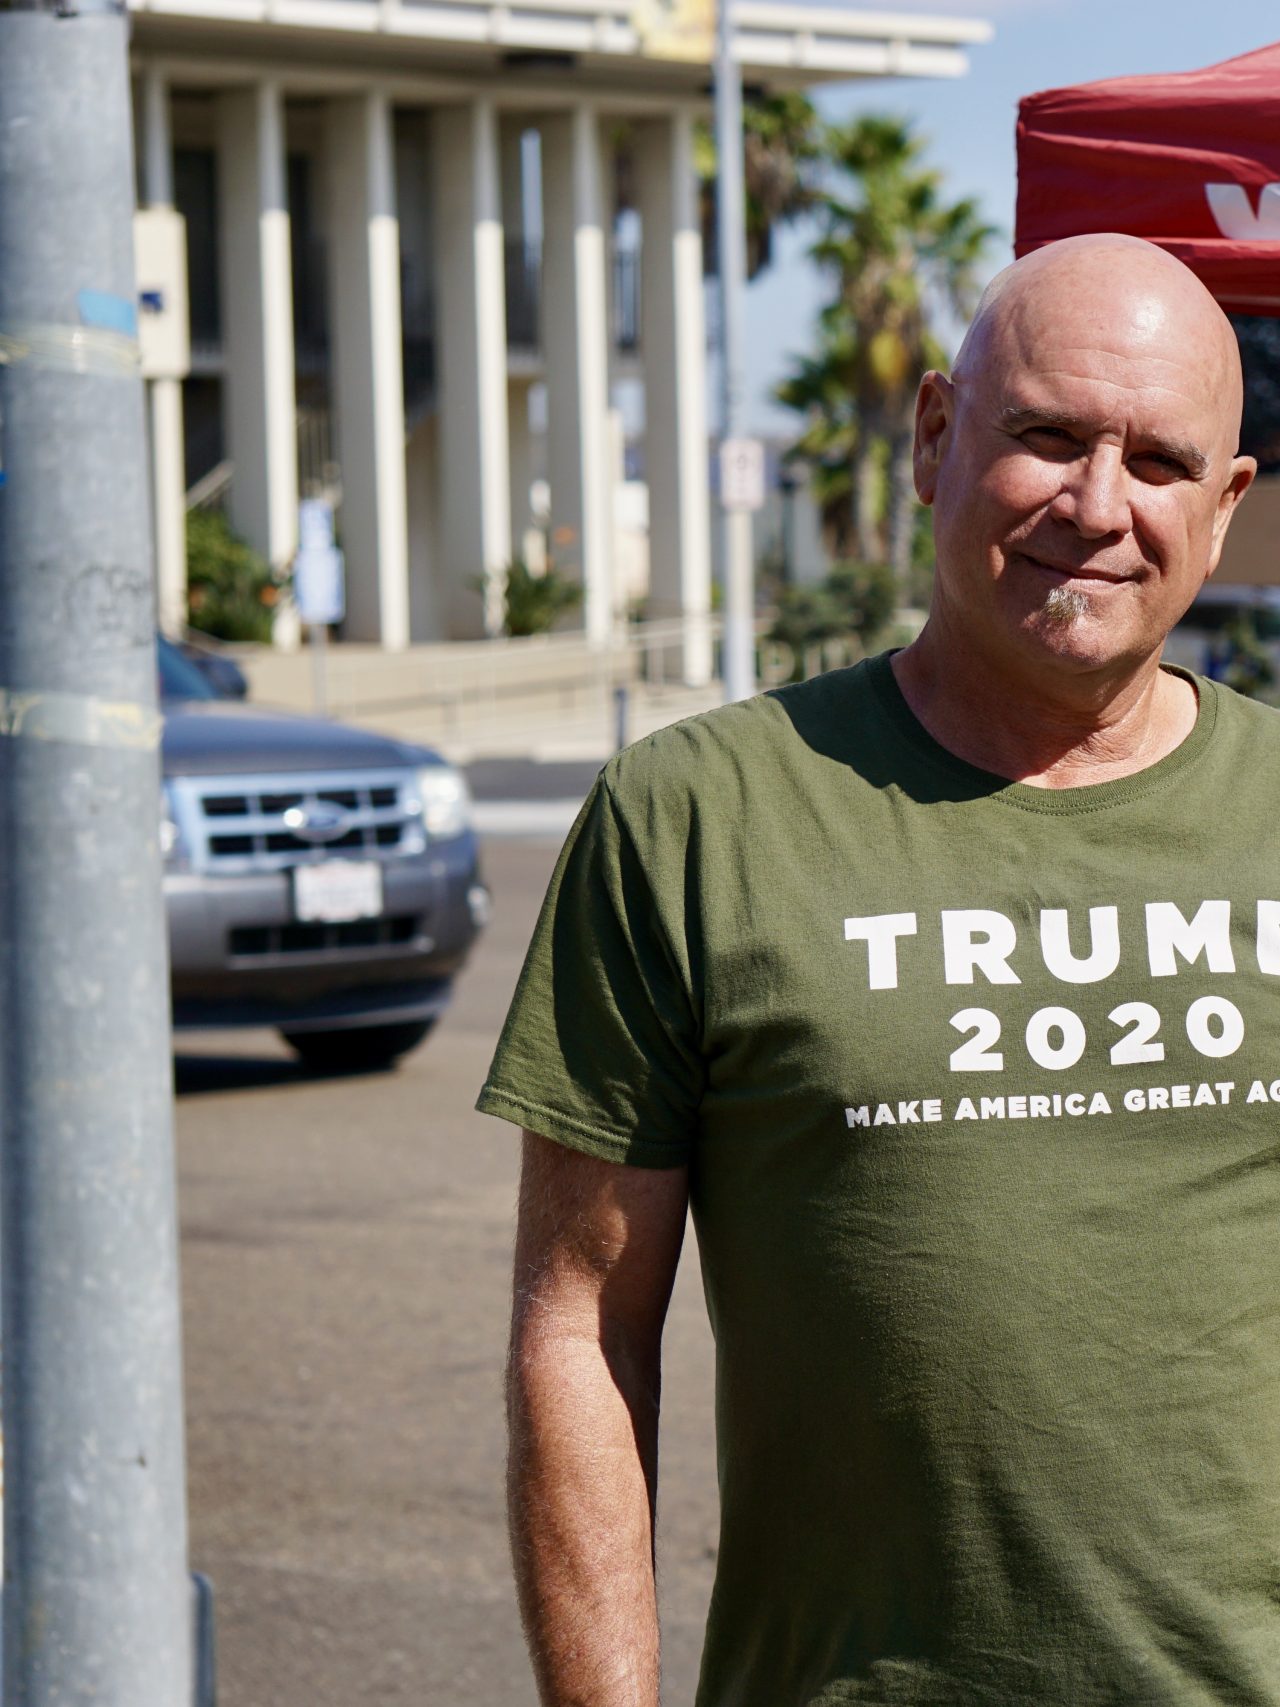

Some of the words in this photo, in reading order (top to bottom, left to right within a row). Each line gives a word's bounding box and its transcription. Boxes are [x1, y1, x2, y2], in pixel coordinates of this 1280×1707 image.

[949, 996, 1244, 1072] 2020
[846, 1100, 943, 1129] MAKE
[954, 1094, 1112, 1122] AMERICA
[1123, 1081, 1236, 1111] GREAT
